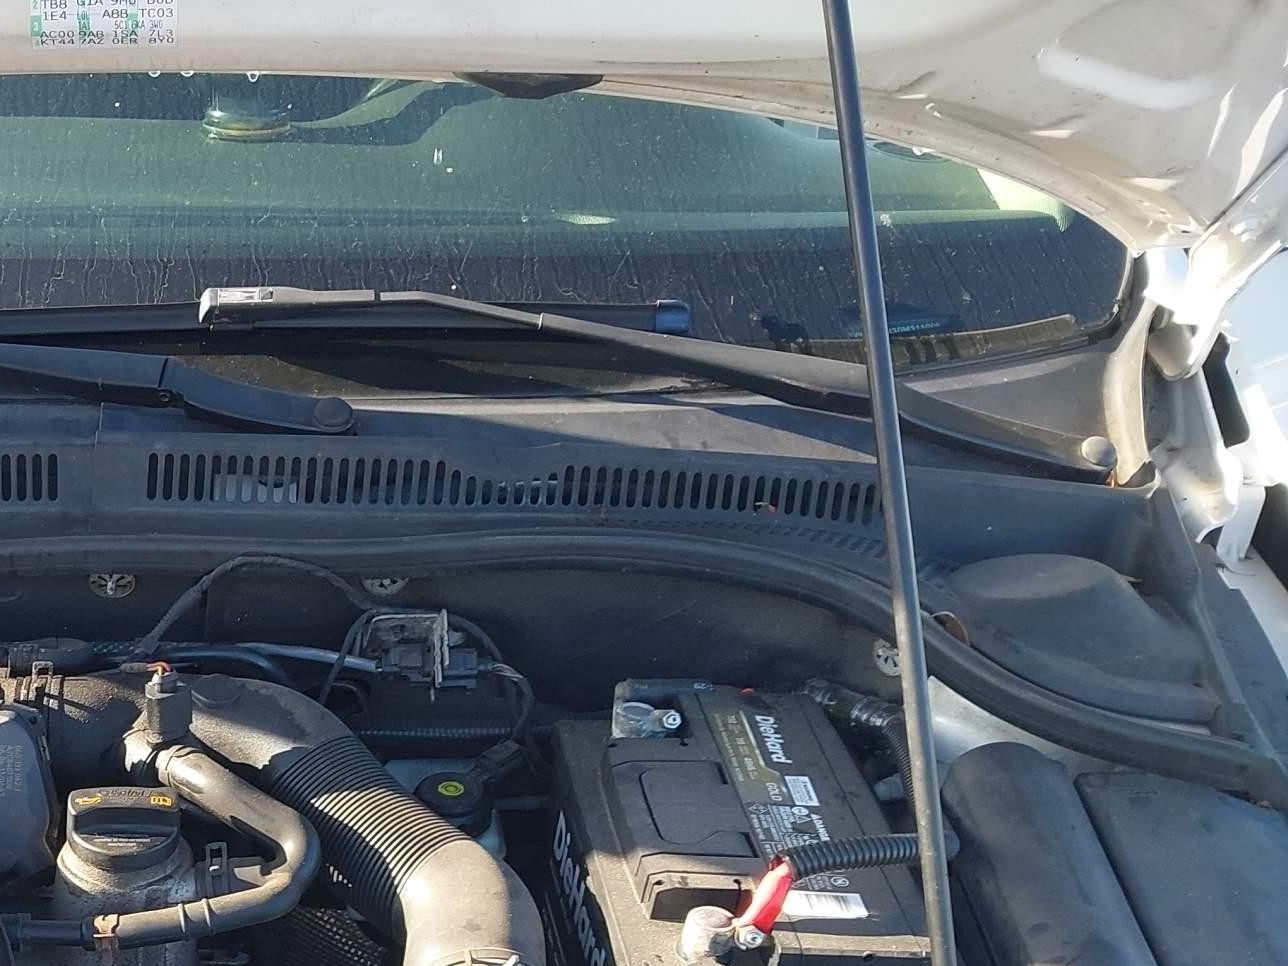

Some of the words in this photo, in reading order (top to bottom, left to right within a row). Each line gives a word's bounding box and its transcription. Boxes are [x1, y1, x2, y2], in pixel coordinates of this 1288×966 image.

[43, 11, 67, 20] 1E4
[755, 715, 793, 764] DieHard
[766, 782, 783, 801] GOLD
